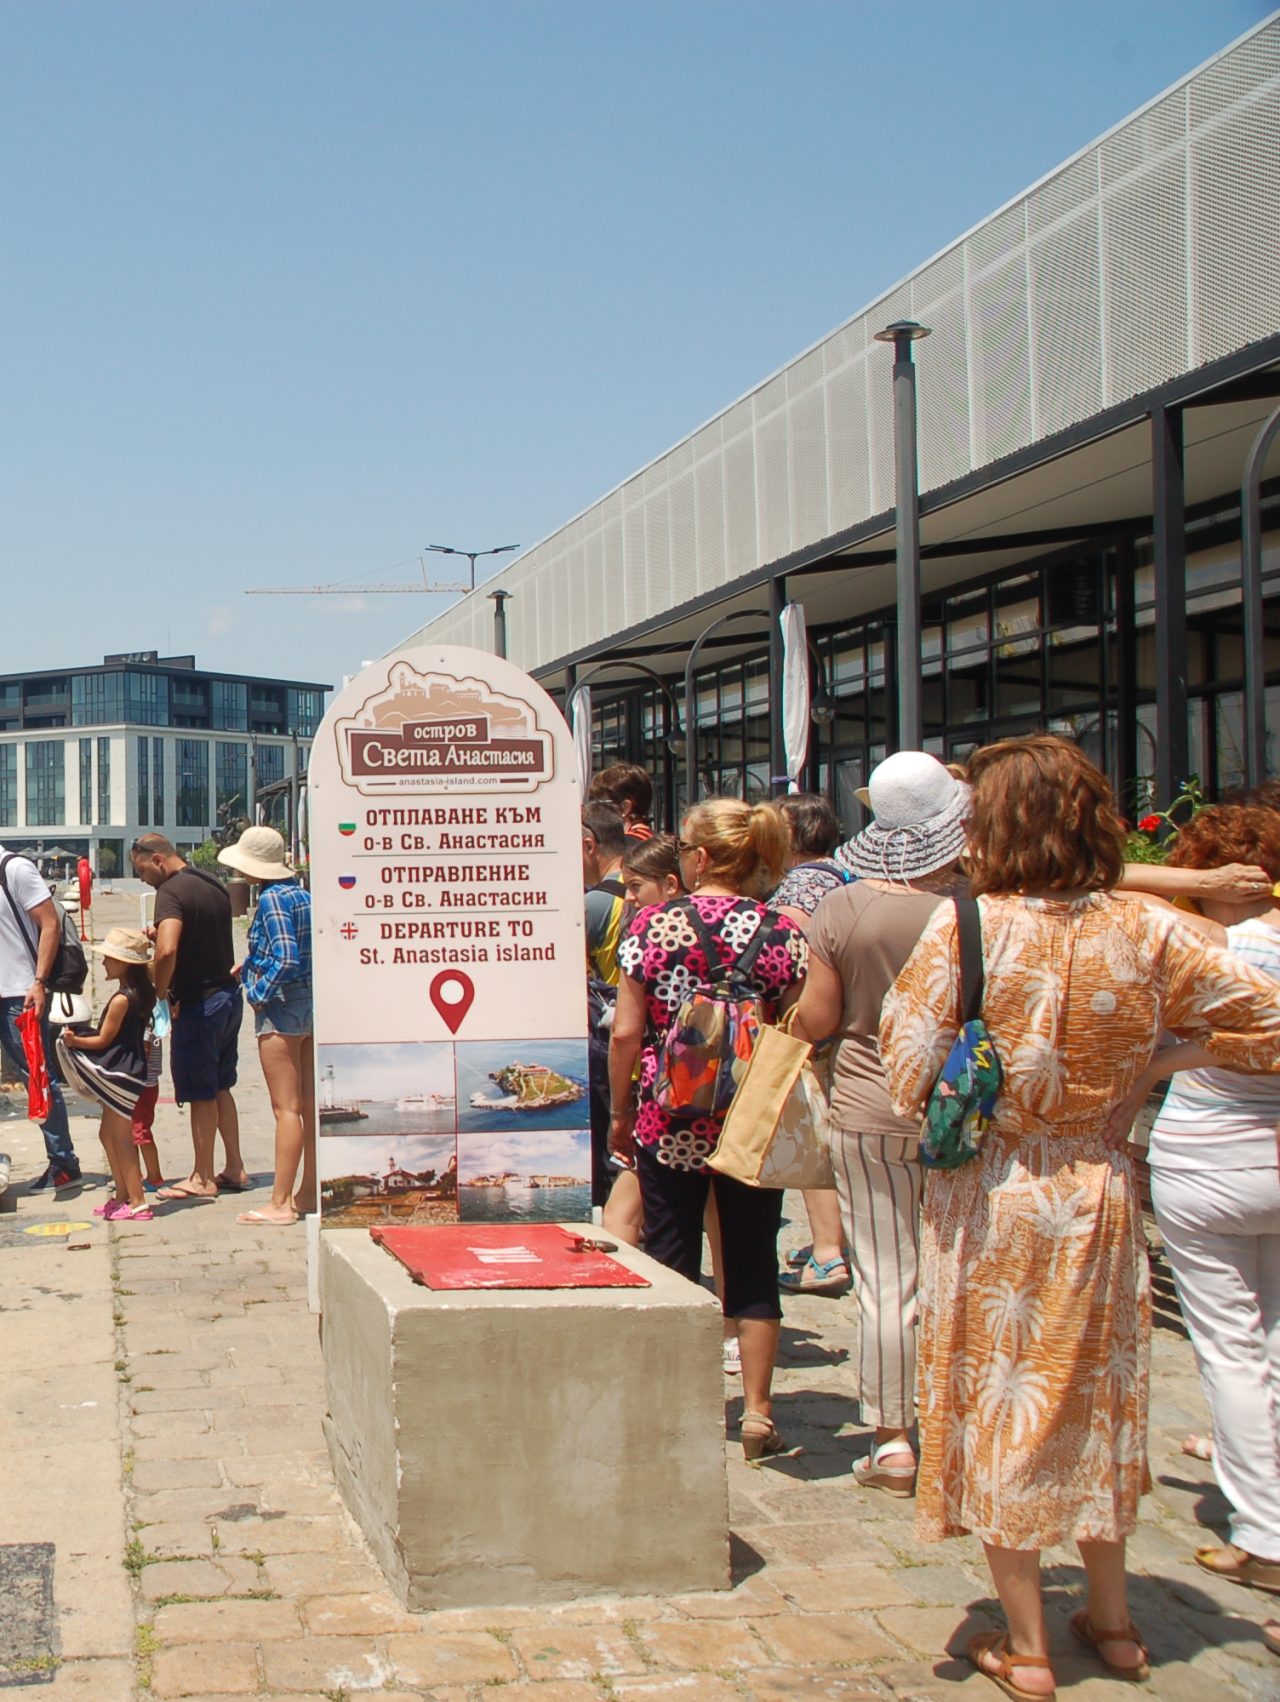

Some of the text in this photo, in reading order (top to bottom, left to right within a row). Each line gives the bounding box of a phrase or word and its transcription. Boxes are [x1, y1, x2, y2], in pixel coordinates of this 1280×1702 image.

[414, 724, 477, 743] остров
[363, 741, 535, 767] Света Анастасия
[398, 776, 498, 787] anastasia-island.com
[366, 807, 542, 826] ОТПЛАВАНЕ КЪМ
[363, 833, 545, 851] о-в Св. Анастасия
[380, 865, 530, 884] ОТПРАВЛЕНИЕ
[365, 890, 548, 909] о-в Св. Анастасии
[380, 920, 534, 940] DEPARTURE TO
[359, 942, 556, 965] St. Anastasia island
